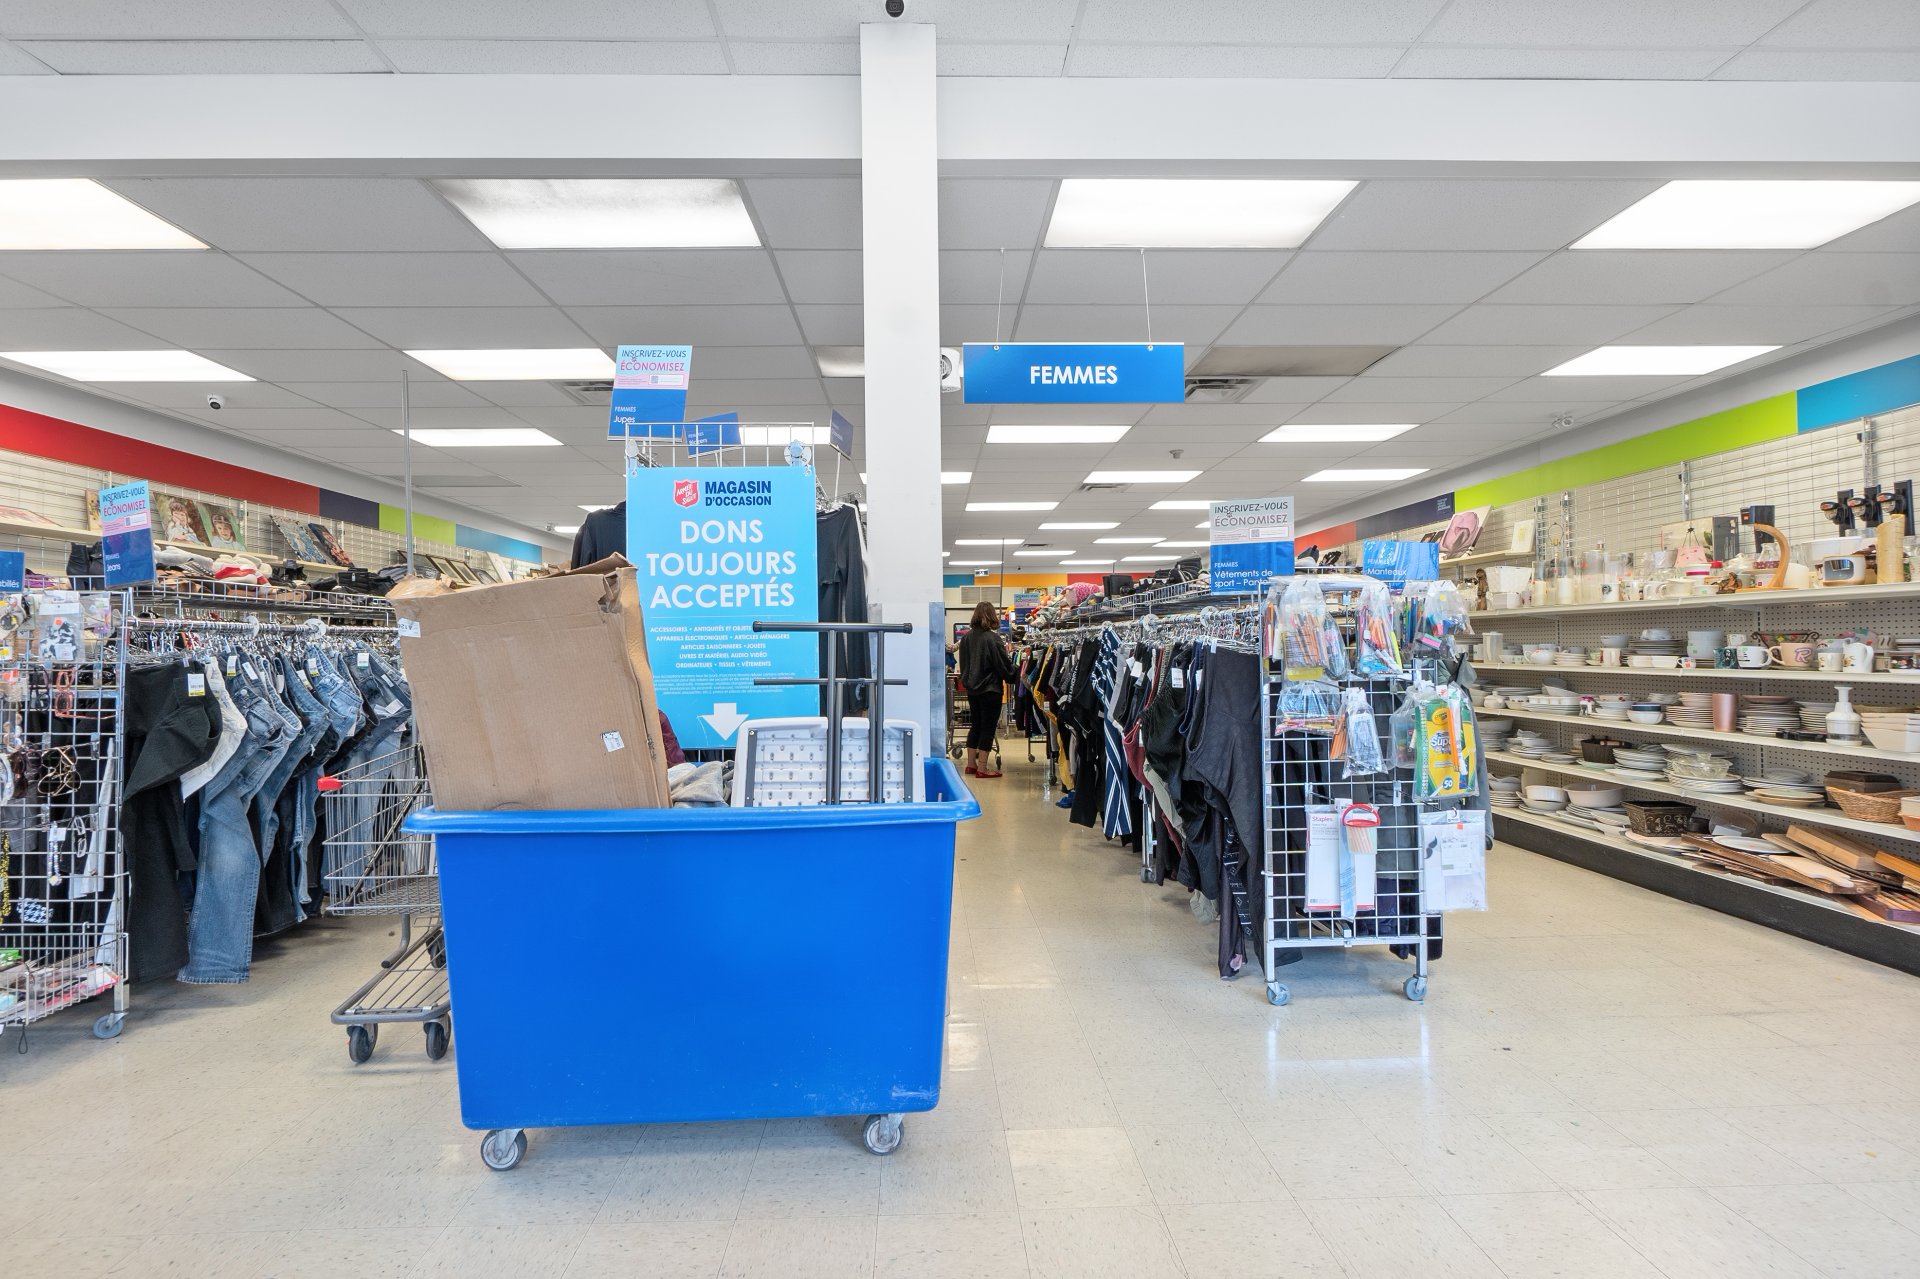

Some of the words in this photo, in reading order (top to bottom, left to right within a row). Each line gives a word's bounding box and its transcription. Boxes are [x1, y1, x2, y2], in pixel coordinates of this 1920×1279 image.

[622, 350, 687, 358] INSCRIVEZ-VOUS
[620, 360, 685, 371] ÉCONOMISEZ
[1030, 366, 1118, 384] FEMMES
[613, 415, 636, 424] Jupes
[705, 481, 772, 494] MAGASIN
[102, 487, 145, 502] INSCRIVEZ-VOUS
[705, 496, 772, 506] D'OCCASION
[104, 500, 146, 516] ÉCONOMISEZ
[1214, 502, 1288, 513] INSCRIVEZ-VOUS
[1215, 514, 1287, 527] ÉCONOMISEZ
[681, 520, 763, 544] DONS
[106, 563, 121, 572] Jeans
[646, 551, 797, 576] TOUJOURS
[1214, 570, 1259, 578] Vêtements
[1261, 569, 1273, 577] de
[1367, 568, 1407, 576] Manteaux
[1214, 580, 1235, 588] sport
[650, 576, 795, 609] ACCEPTÉS
